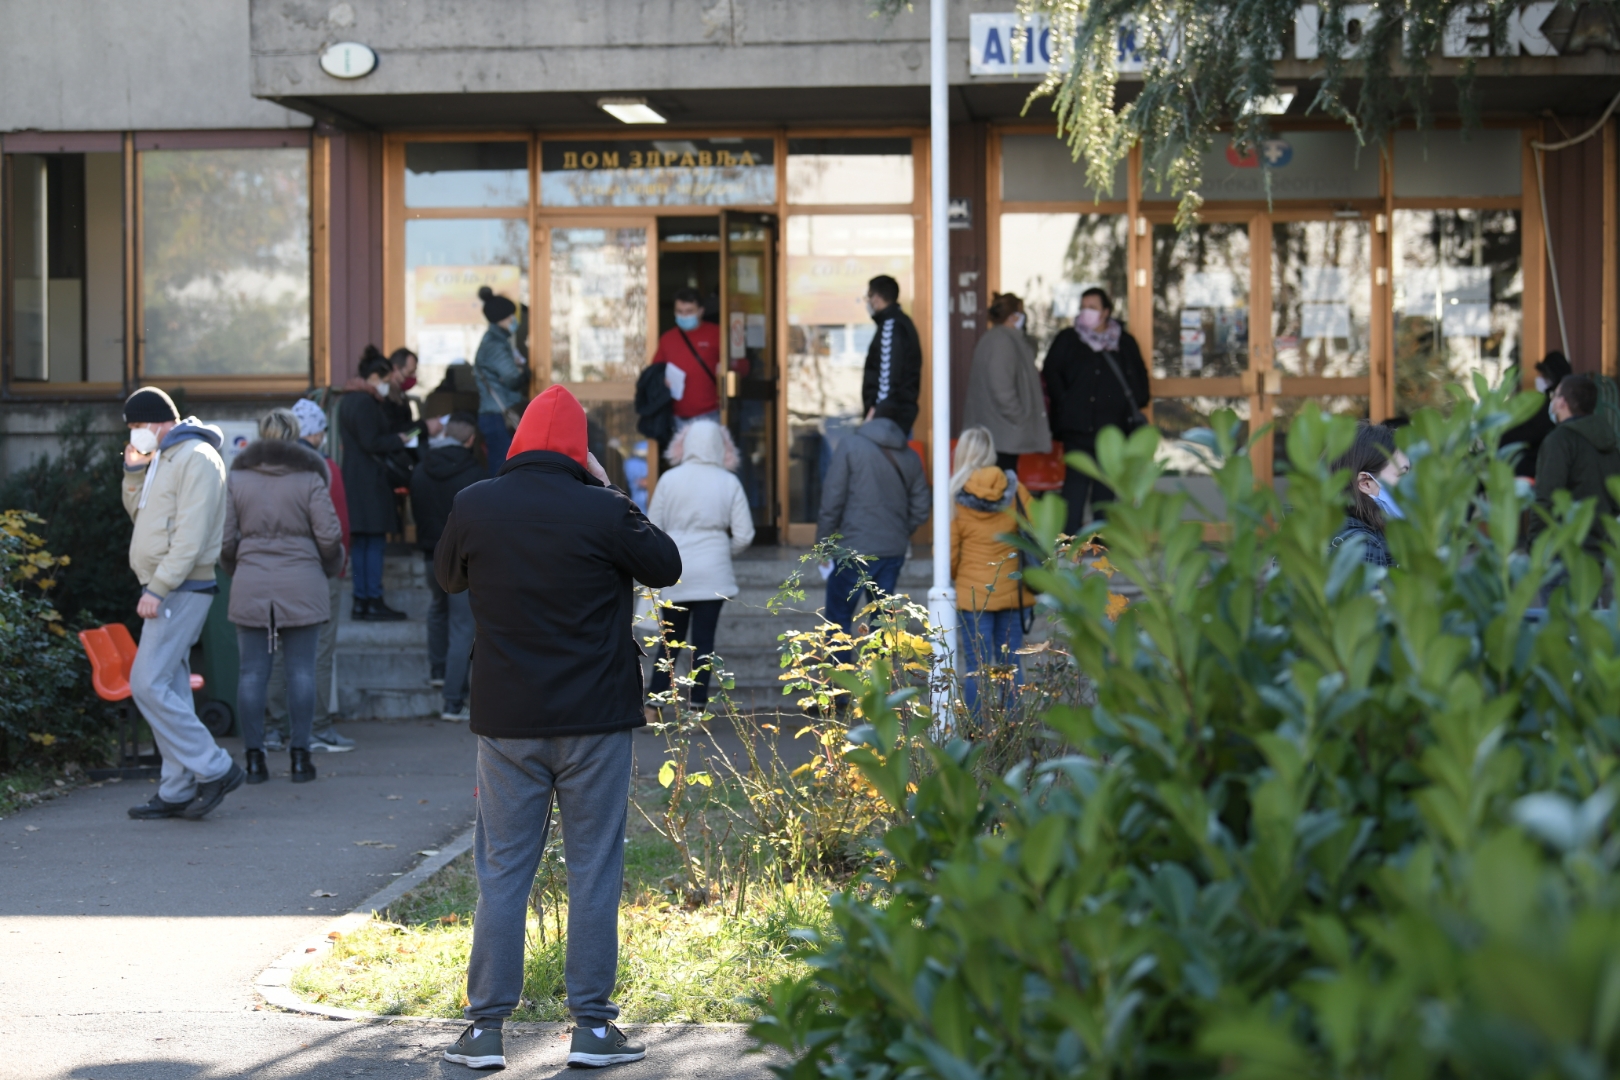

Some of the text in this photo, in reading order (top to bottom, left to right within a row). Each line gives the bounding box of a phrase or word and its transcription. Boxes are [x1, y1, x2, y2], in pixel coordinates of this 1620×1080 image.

[981, 26, 1168, 64] АПОК
[562, 150, 755, 169] ДОМ ЗДРАВЉА
